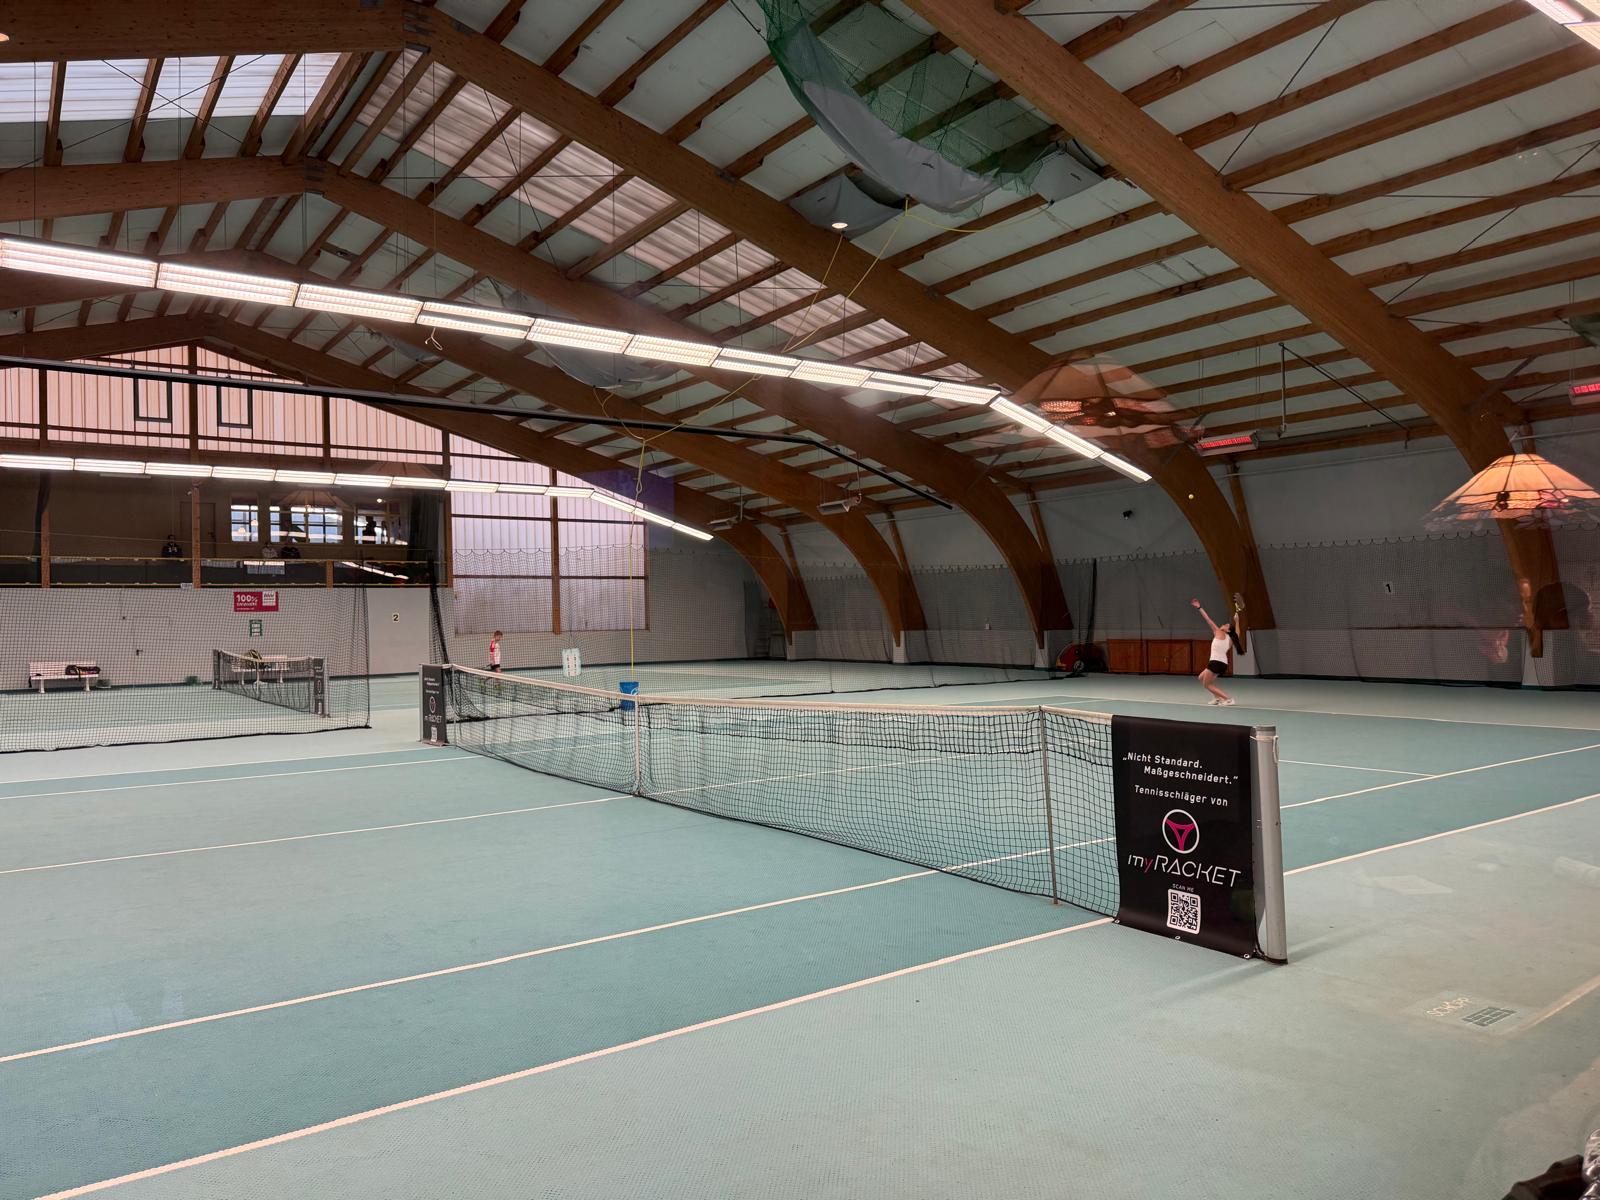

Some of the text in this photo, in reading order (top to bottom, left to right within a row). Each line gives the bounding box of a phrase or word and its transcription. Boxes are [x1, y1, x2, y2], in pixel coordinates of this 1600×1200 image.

[236, 594, 258, 602] 100%
[393, 614, 399, 622] 2
[1154, 755, 1203, 769] Standard.
[1134, 784, 1229, 807] Tennisschläger von
[1127, 854, 1242, 888] myRACKET
[1172, 883, 1186, 891] SCAN
